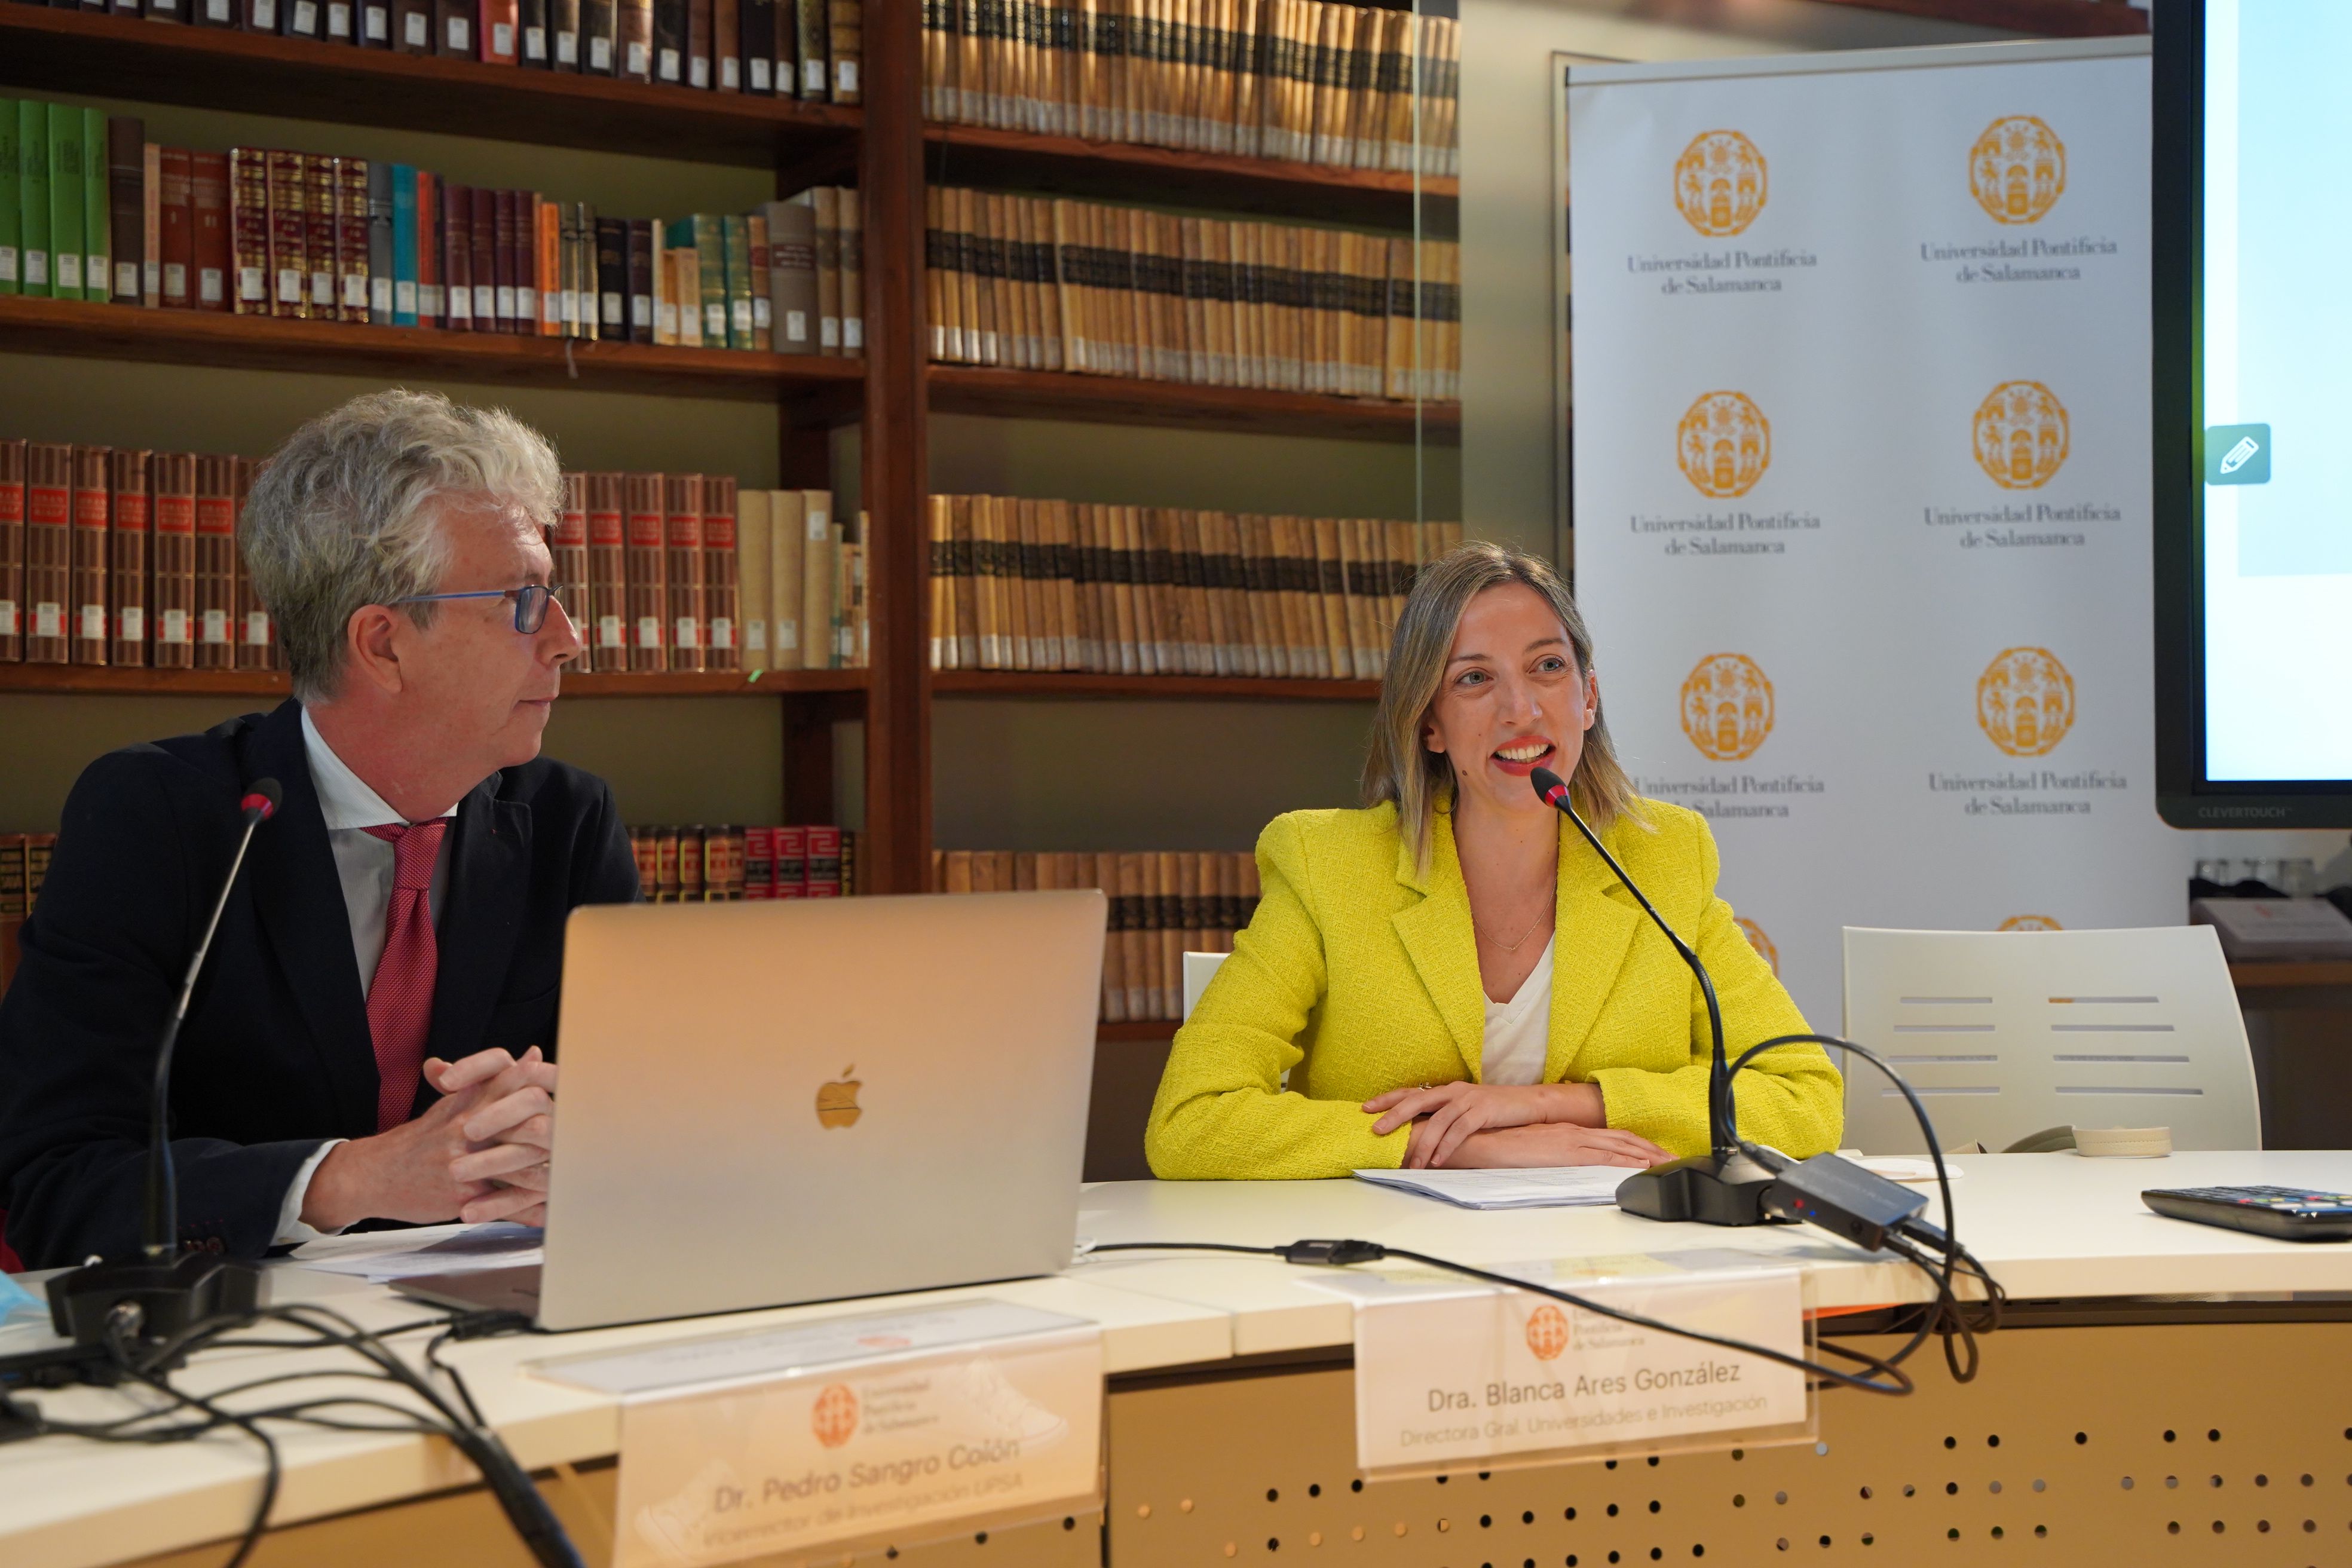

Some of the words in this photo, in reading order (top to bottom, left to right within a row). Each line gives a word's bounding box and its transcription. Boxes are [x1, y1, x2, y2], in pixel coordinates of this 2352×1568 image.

[1920, 238, 2028, 262] Universidad
[2032, 235, 2117, 258] Pontificia
[1627, 251, 1731, 274] Universidad
[1735, 249, 1817, 268] Pontificia
[1955, 265, 1979, 283] de
[1981, 262, 2081, 282] Salamanca
[1660, 277, 1683, 295] de
[1686, 275, 1782, 293] Salamanca
[1630, 513, 1734, 534] Universidad
[1738, 510, 1820, 531] Pontificia
[1924, 504, 2032, 526] Universidad
[2036, 502, 2121, 522] Pontificia
[1664, 538, 1687, 555] de
[1689, 537, 1785, 555] Salamanca
[1959, 529, 1982, 549] de
[1984, 528, 2085, 548] Salamanca
[1741, 774, 1824, 794] Pontificia
[1928, 771, 2037, 792] Universidad
[2041, 770, 2127, 790] Pontificia
[1964, 796, 1987, 815] de
[1989, 795, 2091, 815] Salamanca
[1428, 1389, 1477, 1412] Dra.
[1486, 1381, 1565, 1407] Blanca
[1574, 1373, 1627, 1398] Ares
[1634, 1362, 1741, 1391] González
[1399, 1426, 1480, 1448] Directora
[1527, 1405, 1643, 1435] Universidades
[1647, 1407, 1658, 1422] e
[1661, 1394, 1768, 1419] Investigación
[713, 1484, 754, 1513] Dr.
[761, 1468, 843, 1505] Pedro
[848, 1454, 942, 1489] Sangro
